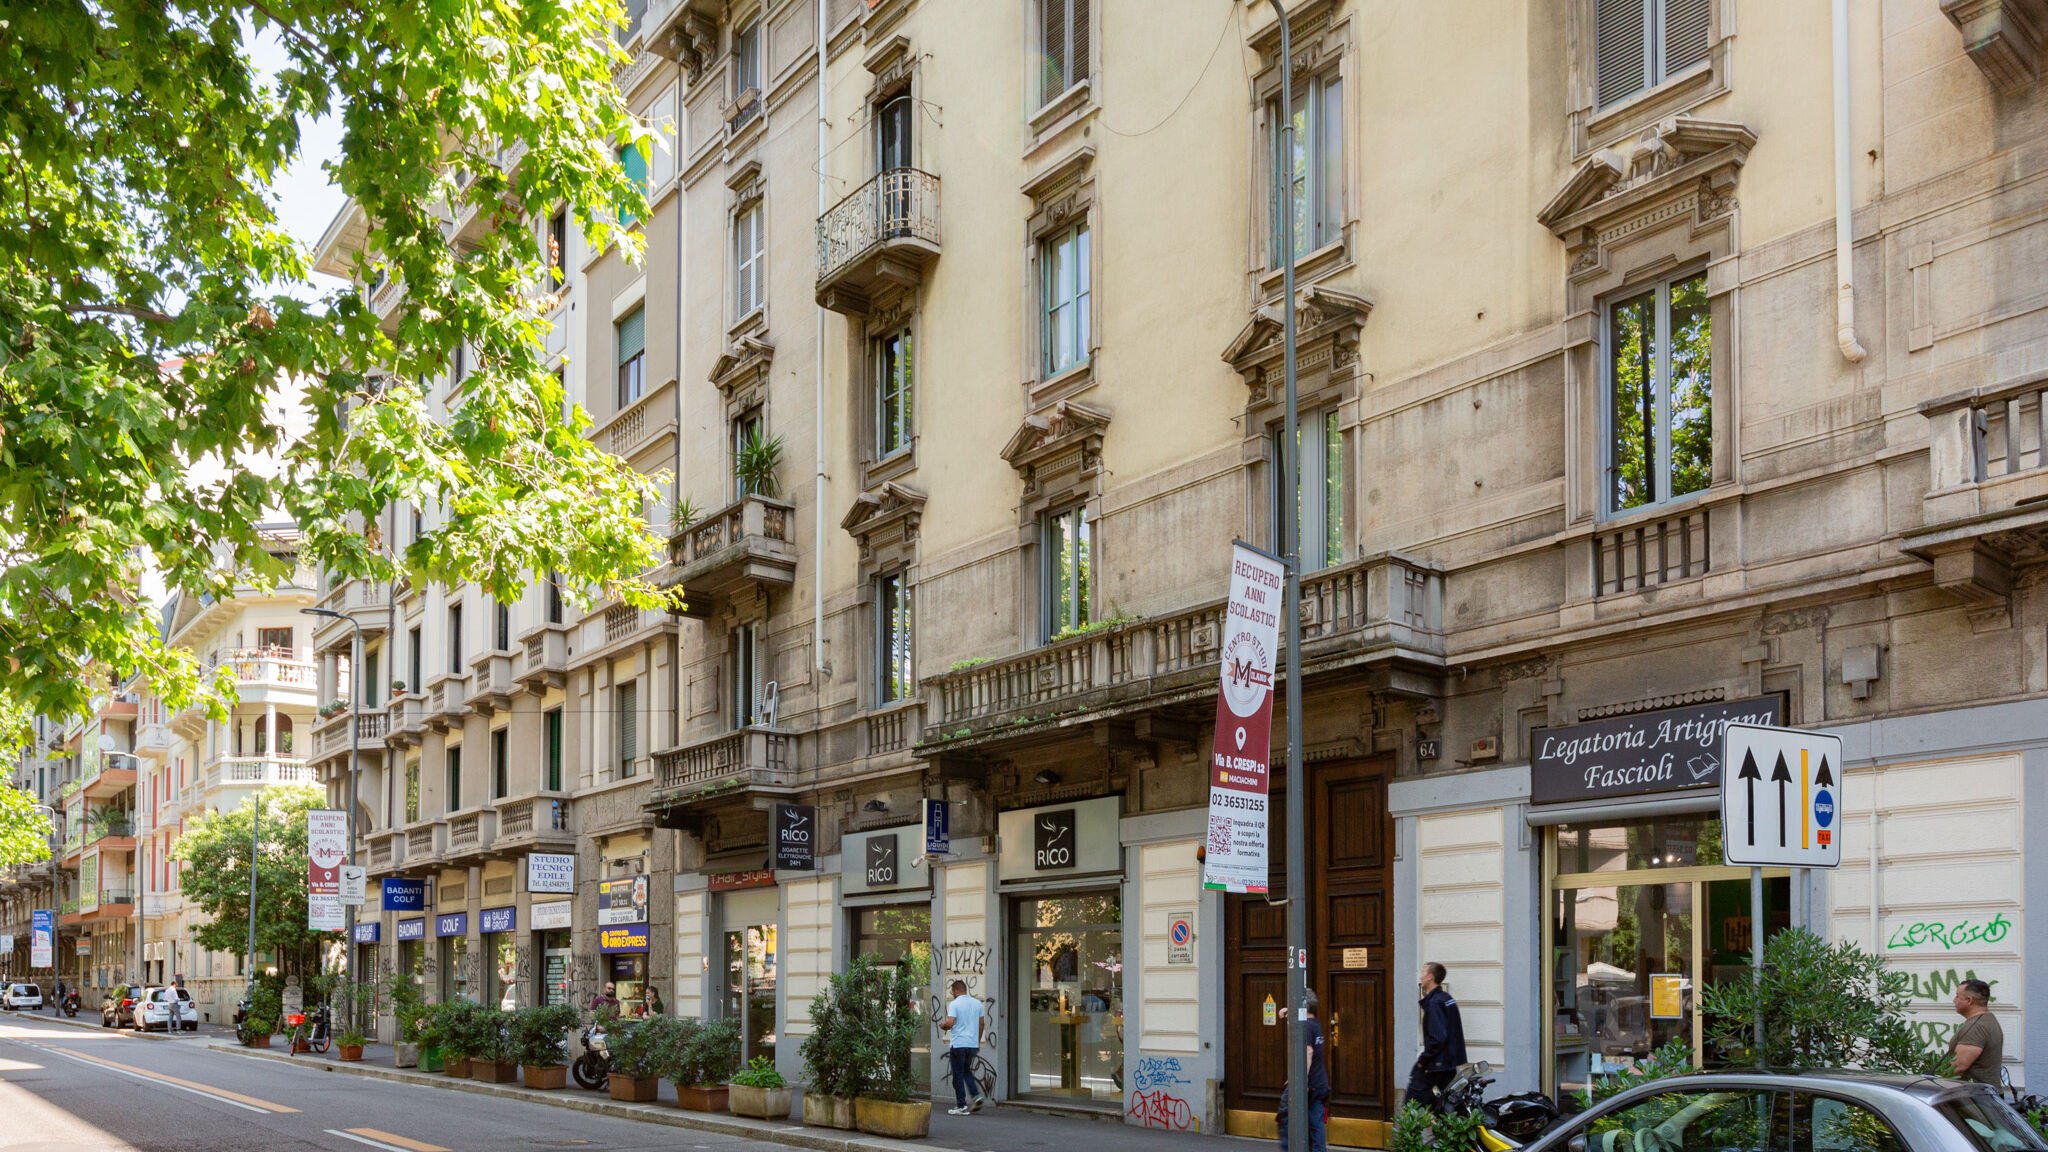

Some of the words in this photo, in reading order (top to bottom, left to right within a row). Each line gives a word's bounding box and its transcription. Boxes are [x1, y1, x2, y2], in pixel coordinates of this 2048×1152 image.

[1234, 560, 1280, 590] RECUPERO
[1244, 587, 1266, 604] ANNI
[1230, 601, 1276, 628] SCOLASTICI
[1224, 632, 1251, 661] CENTRO
[1252, 636, 1268, 669] STUDI
[1420, 743, 1435, 757] 64
[1539, 724, 1645, 765] Legatoria
[1216, 753, 1224, 766] Via
[1226, 756, 1232, 768] B.
[1234, 757, 1256, 774] CRESPI
[1257, 762, 1265, 774] 12
[1584, 753, 1674, 789] Fascioli
[1212, 794, 1222, 806] 02
[1224, 795, 1264, 812] 36531255
[781, 829, 808, 842] RICO
[1818, 833, 1830, 841] TAXI
[534, 856, 570, 864] STUDIO
[1038, 848, 1069, 866] RICO
[531, 864, 573, 872] TECNICO
[868, 867, 892, 882] RICO
[538, 872, 566, 880] EDILE
[492, 910, 510, 920] GALLAS
[361, 924, 373, 933] GALLAS
[398, 922, 423, 937] BADANTI
[442, 918, 459, 933] COLF
[492, 920, 508, 930] GROUP
[361, 932, 372, 941] GROUP
